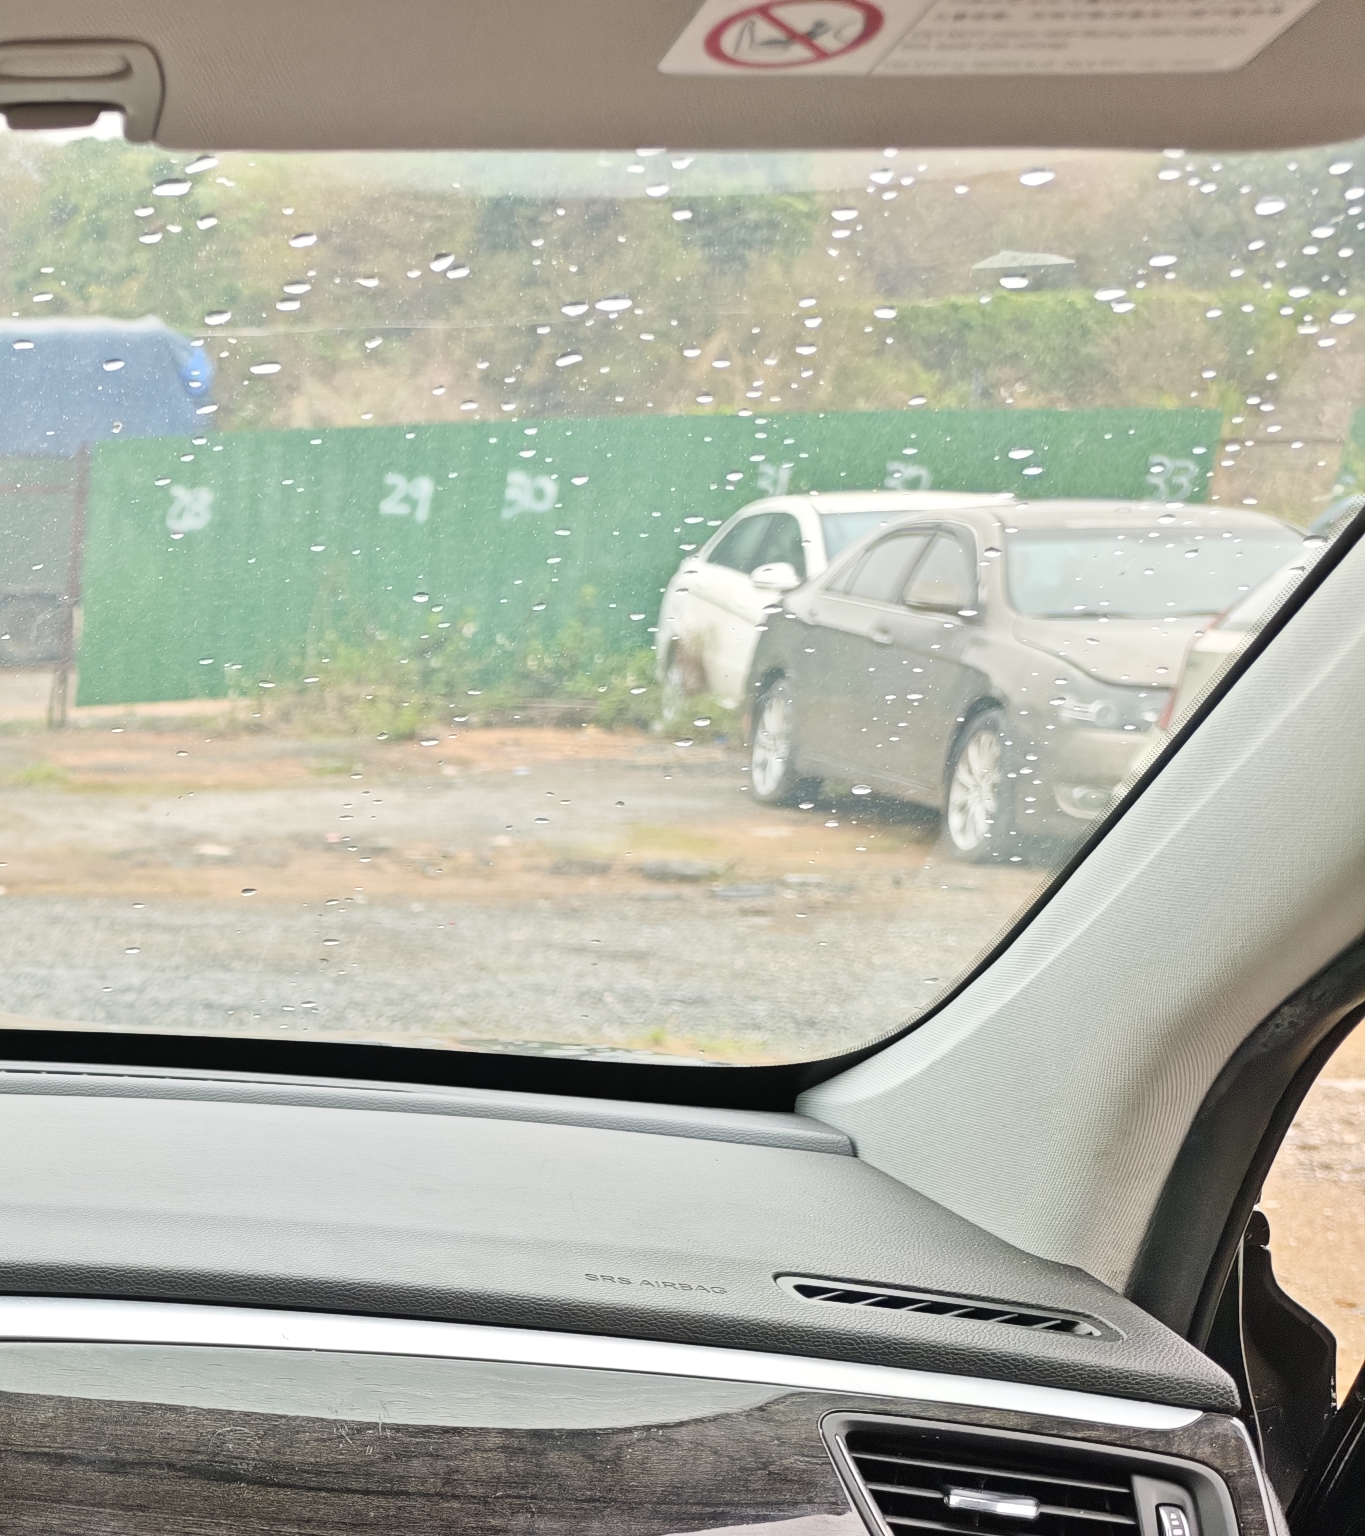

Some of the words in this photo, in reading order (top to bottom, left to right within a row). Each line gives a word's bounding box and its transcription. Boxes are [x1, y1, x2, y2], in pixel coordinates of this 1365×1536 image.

[379, 473, 434, 524] 29
[585, 1273, 632, 1285] SRS
[639, 1279, 727, 1294] AIRBAG
